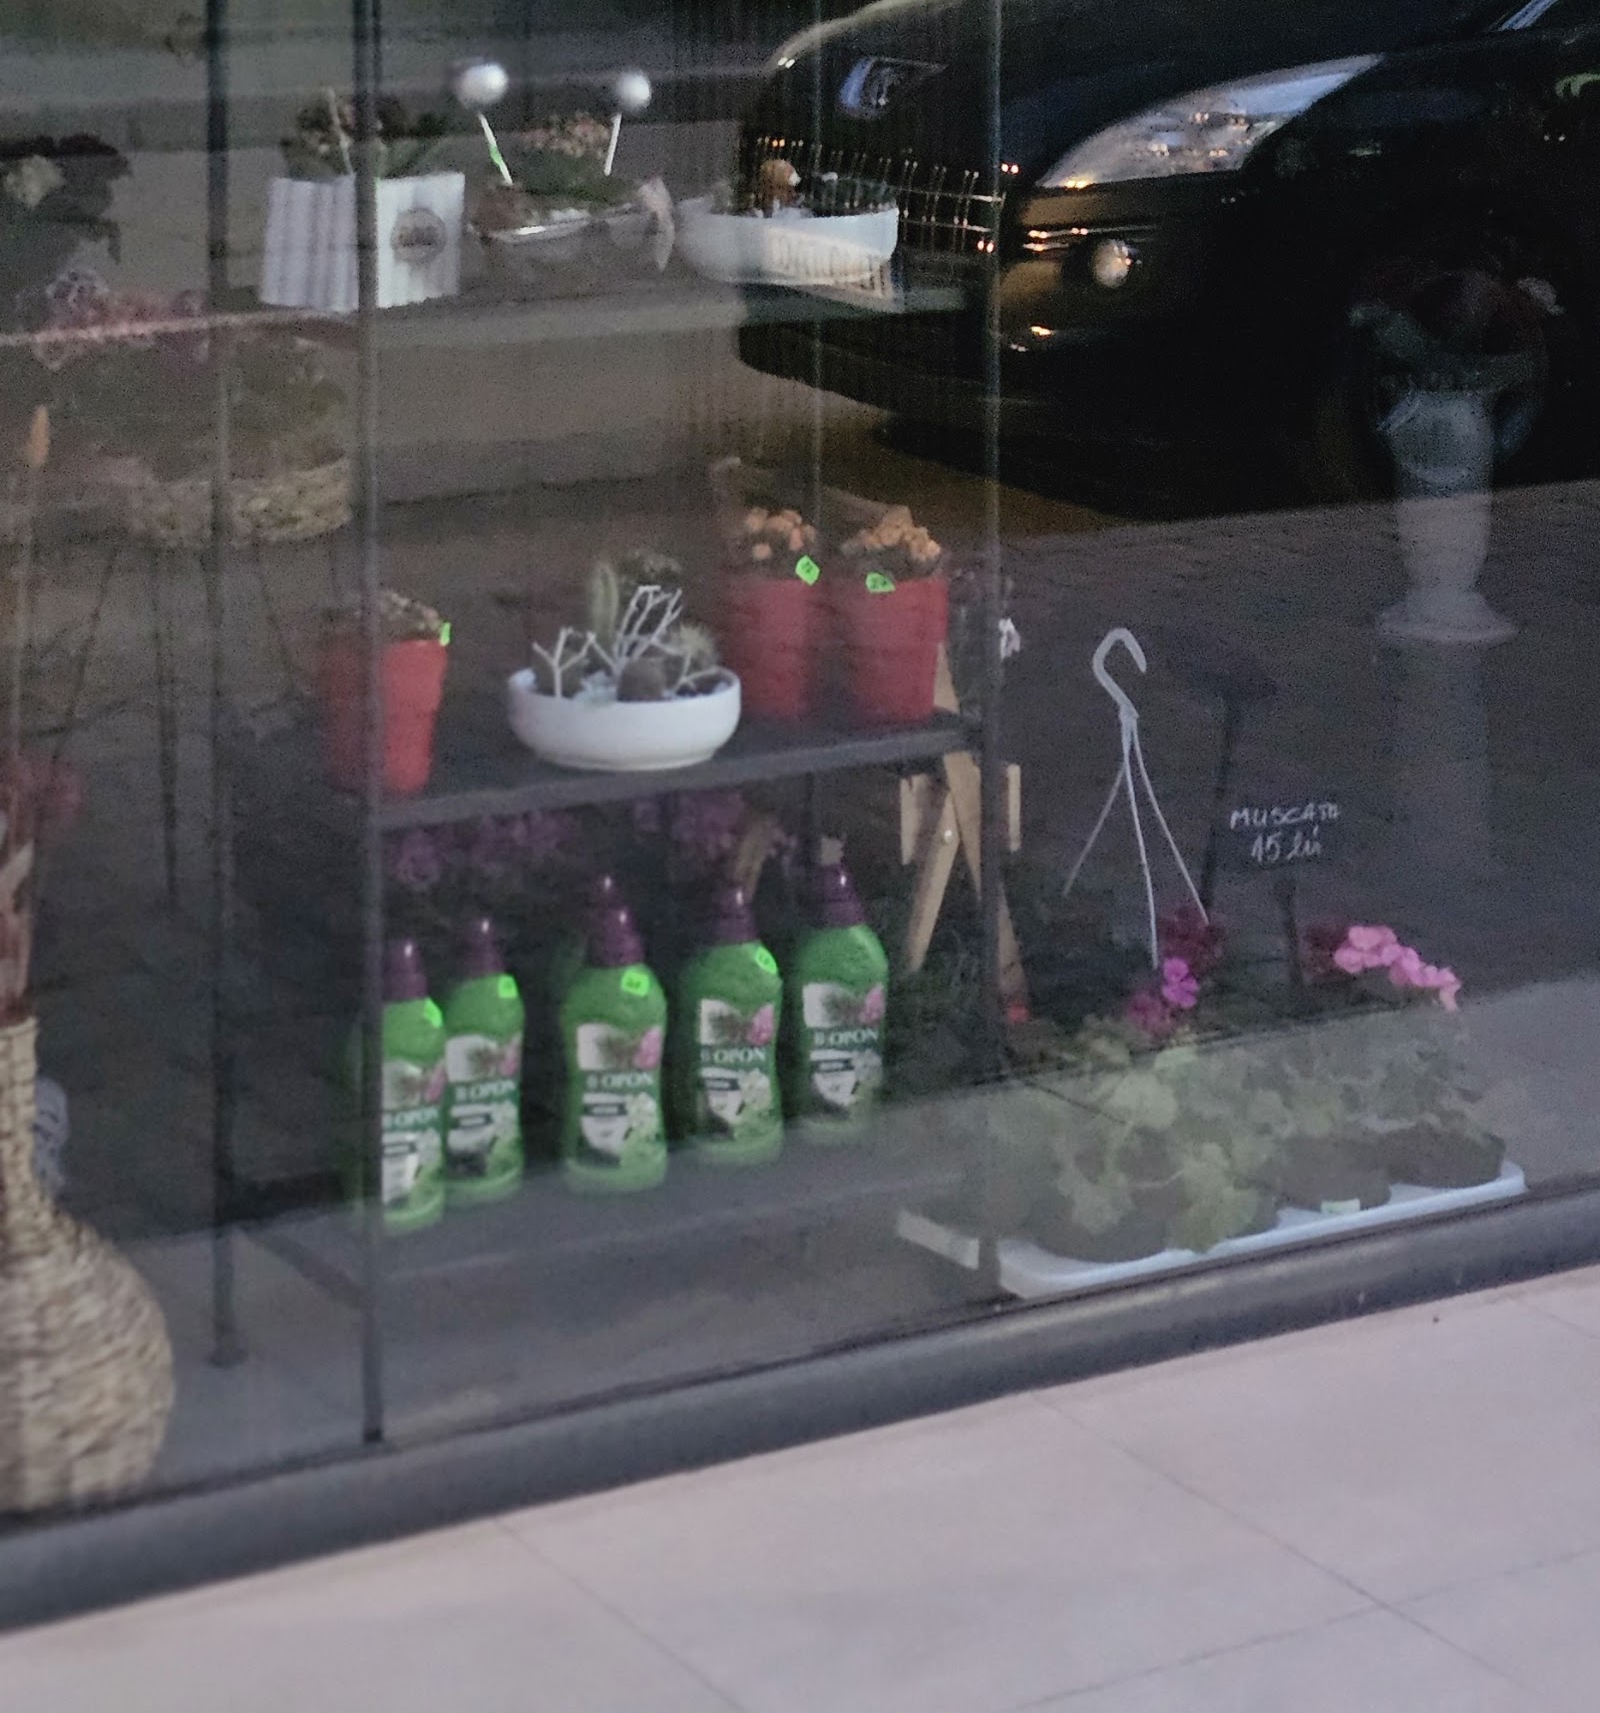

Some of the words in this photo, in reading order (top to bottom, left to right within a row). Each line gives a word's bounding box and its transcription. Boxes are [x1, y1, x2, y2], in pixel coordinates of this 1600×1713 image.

[1251, 832, 1281, 863] 15
[815, 1028, 879, 1046] BOPON
[700, 1046, 766, 1064] BOPON
[586, 1072, 654, 1089] BOPON
